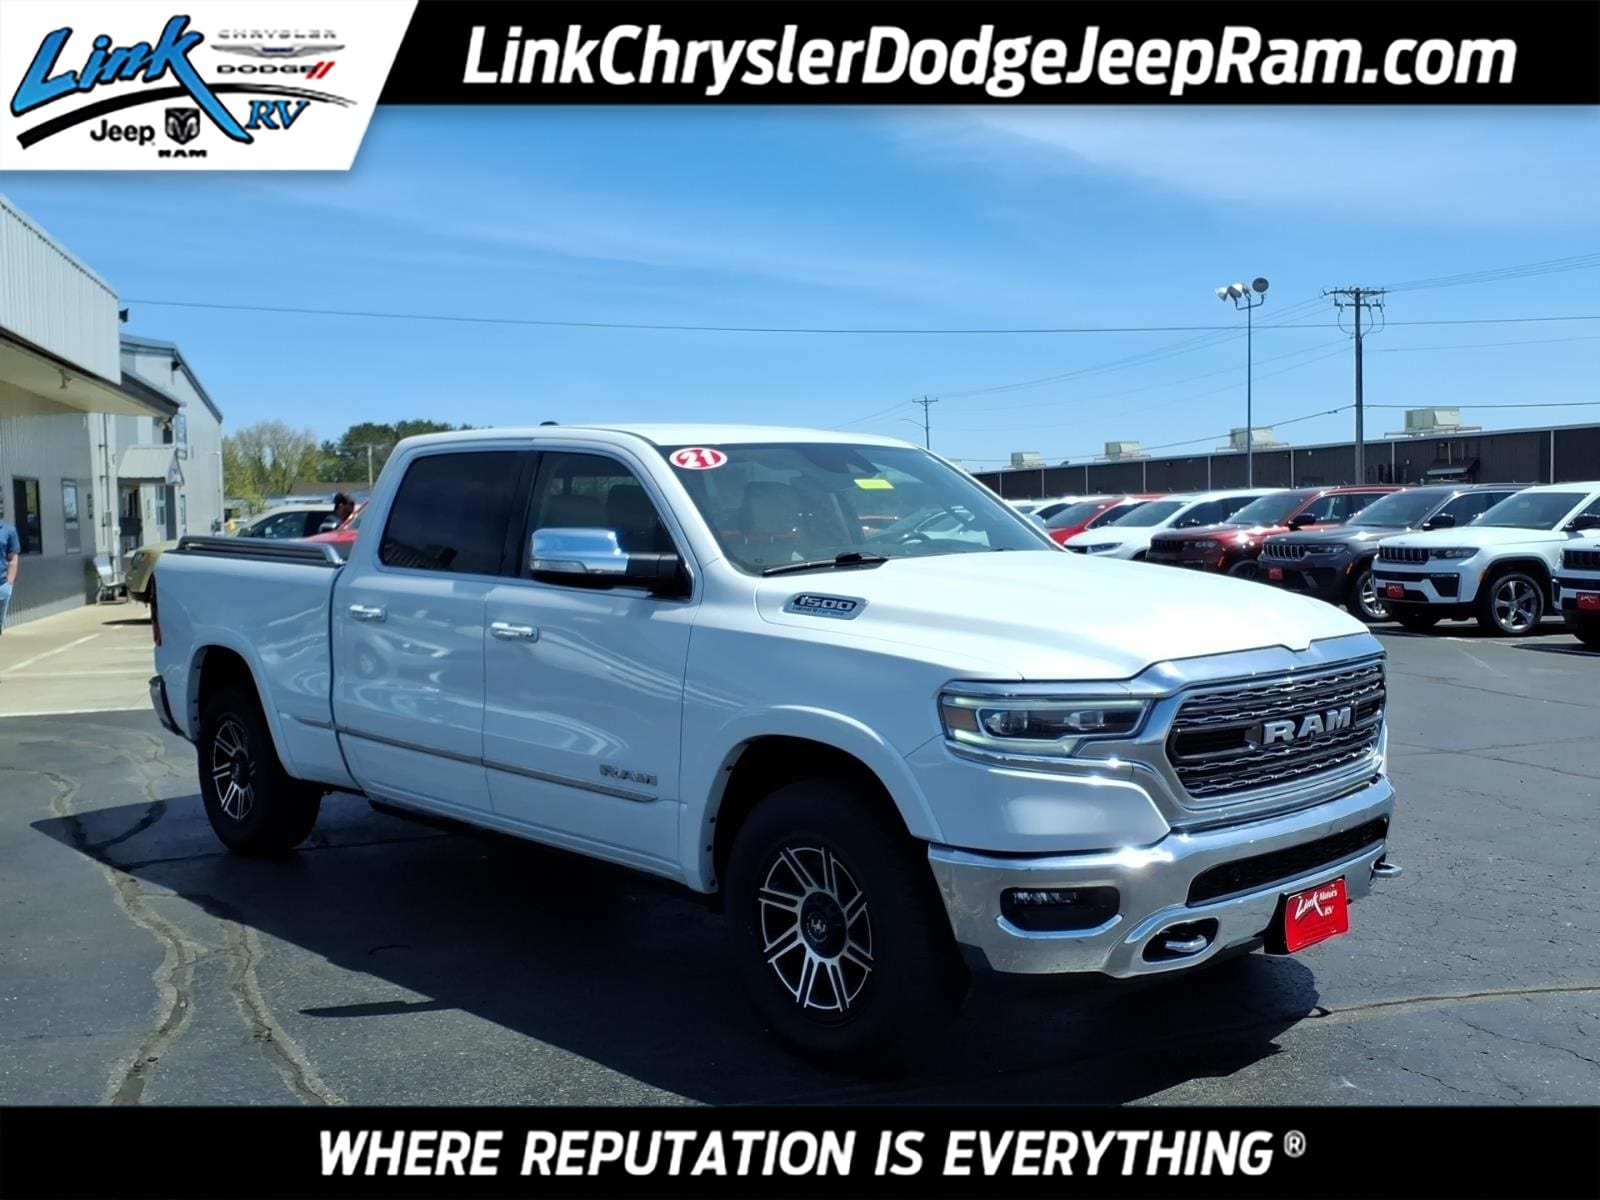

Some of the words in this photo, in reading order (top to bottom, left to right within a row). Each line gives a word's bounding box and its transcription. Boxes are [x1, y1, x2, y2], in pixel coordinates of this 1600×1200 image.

[677, 449, 719, 468] 21
[799, 595, 855, 612] 1500
[1263, 706, 1352, 745] RAM
[599, 764, 658, 786] RAM
[1294, 891, 1324, 920] Link
